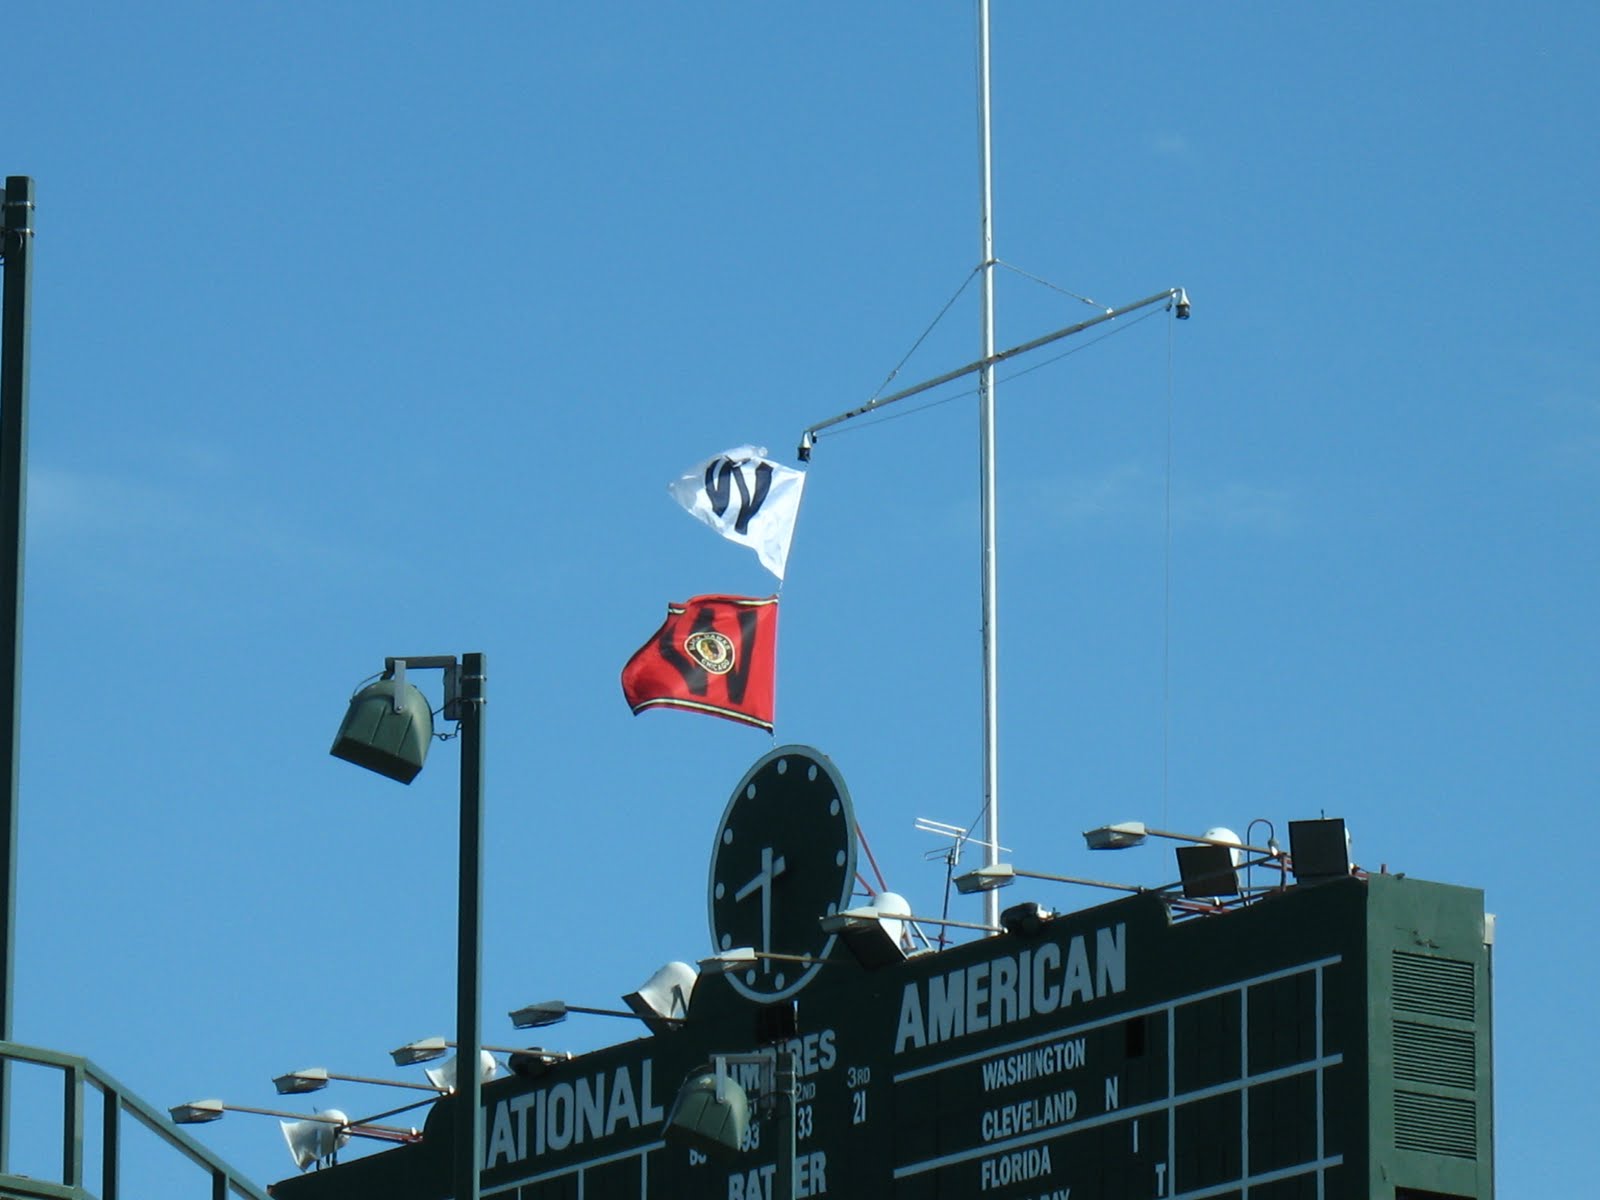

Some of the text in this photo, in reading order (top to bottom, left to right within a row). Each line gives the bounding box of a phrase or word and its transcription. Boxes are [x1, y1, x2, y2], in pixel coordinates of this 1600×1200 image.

[894, 922, 1126, 1055] AMERICAN
[847, 1067, 871, 1088] 3RD
[982, 1037, 1086, 1092] WASHINGTON
[797, 1105, 813, 1139] 33
[853, 1090, 866, 1125] 21
[981, 1089, 1077, 1142] CLEVELAND
[728, 1150, 827, 1200] BATER
[981, 1145, 1051, 1191] FLORIDA
